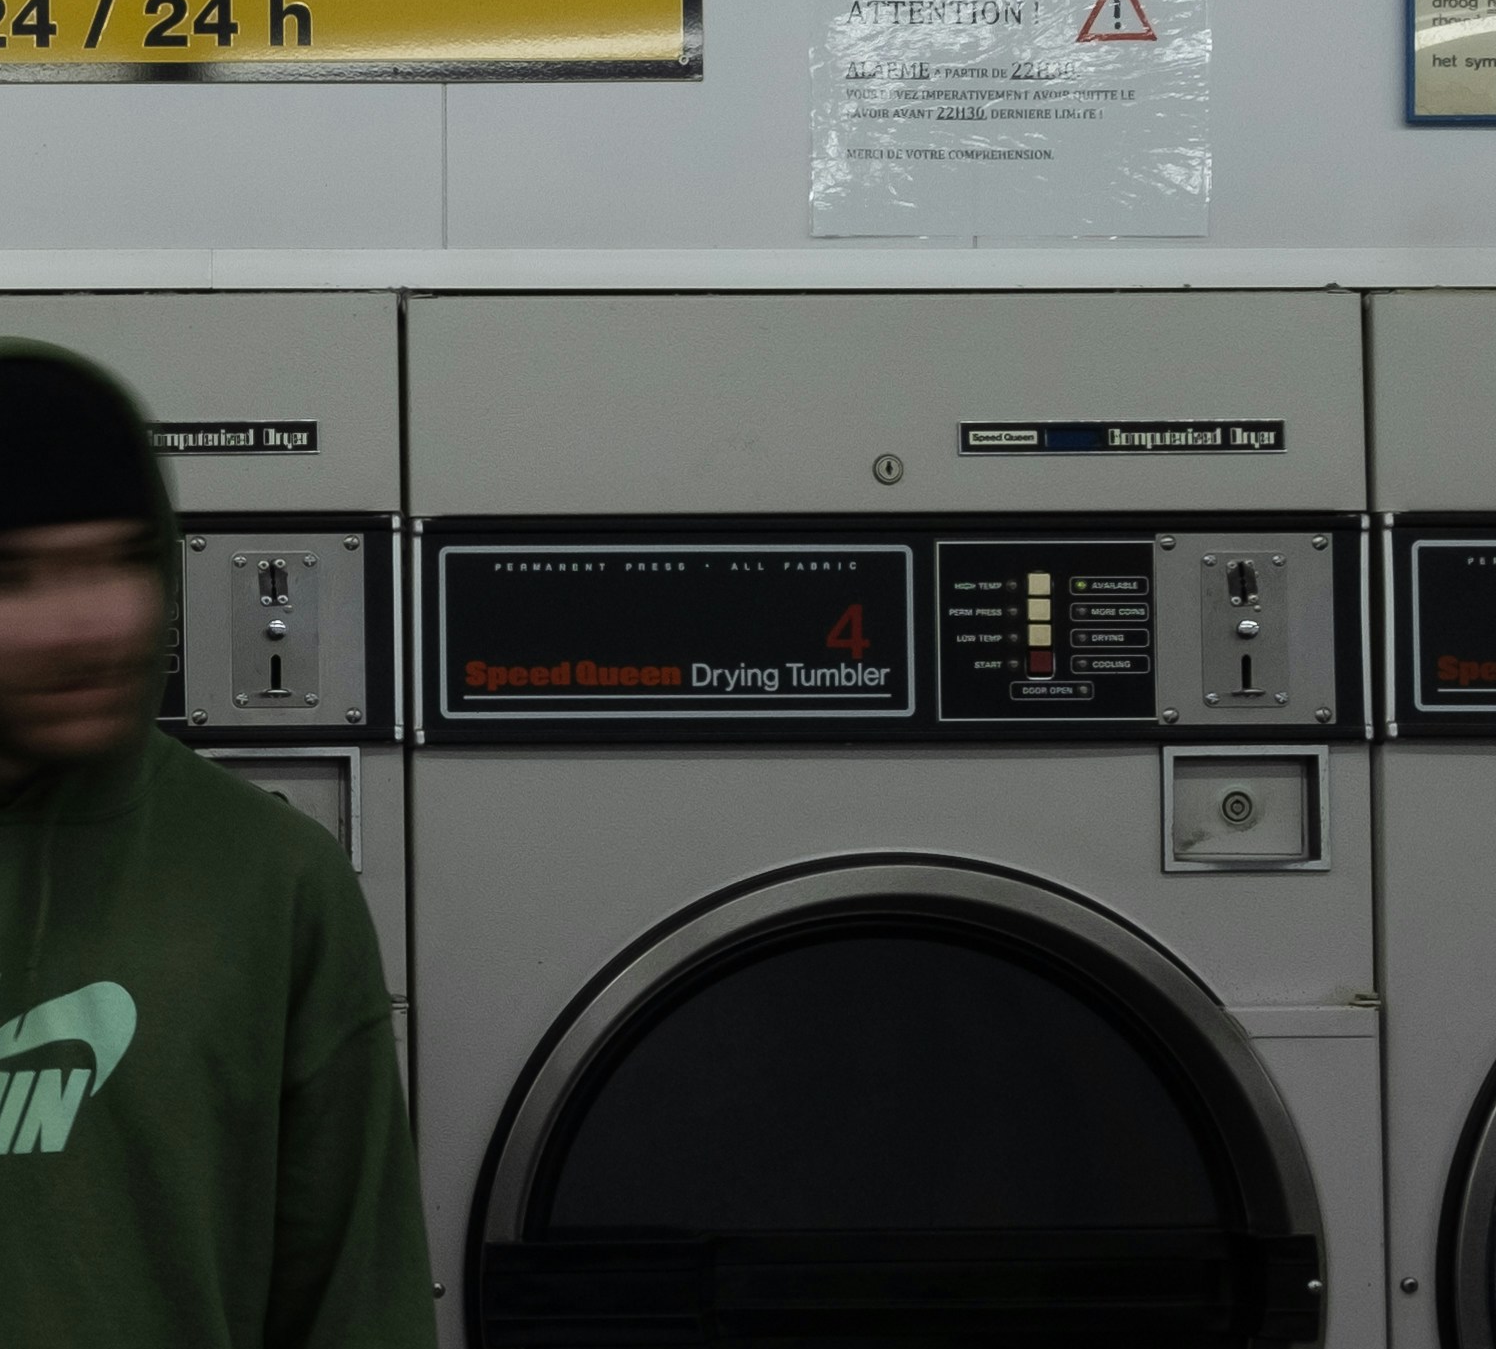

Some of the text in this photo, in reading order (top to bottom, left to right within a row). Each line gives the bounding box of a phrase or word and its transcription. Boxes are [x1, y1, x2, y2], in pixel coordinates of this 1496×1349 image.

[846, 0, 1023, 26] ATTENTION
[1432, 54, 1457, 68] het
[945, 68, 1007, 78] PARTIR DE
[991, 109, 1051, 119] DERNIERE
[847, 150, 883, 159] MERCI
[887, 150, 903, 159] DE
[907, 150, 945, 159] VOTRE
[731, 562, 765, 571] ALL
[826, 604, 871, 660] 4
[464, 660, 891, 691] Speed Queen Drying Tumbler
